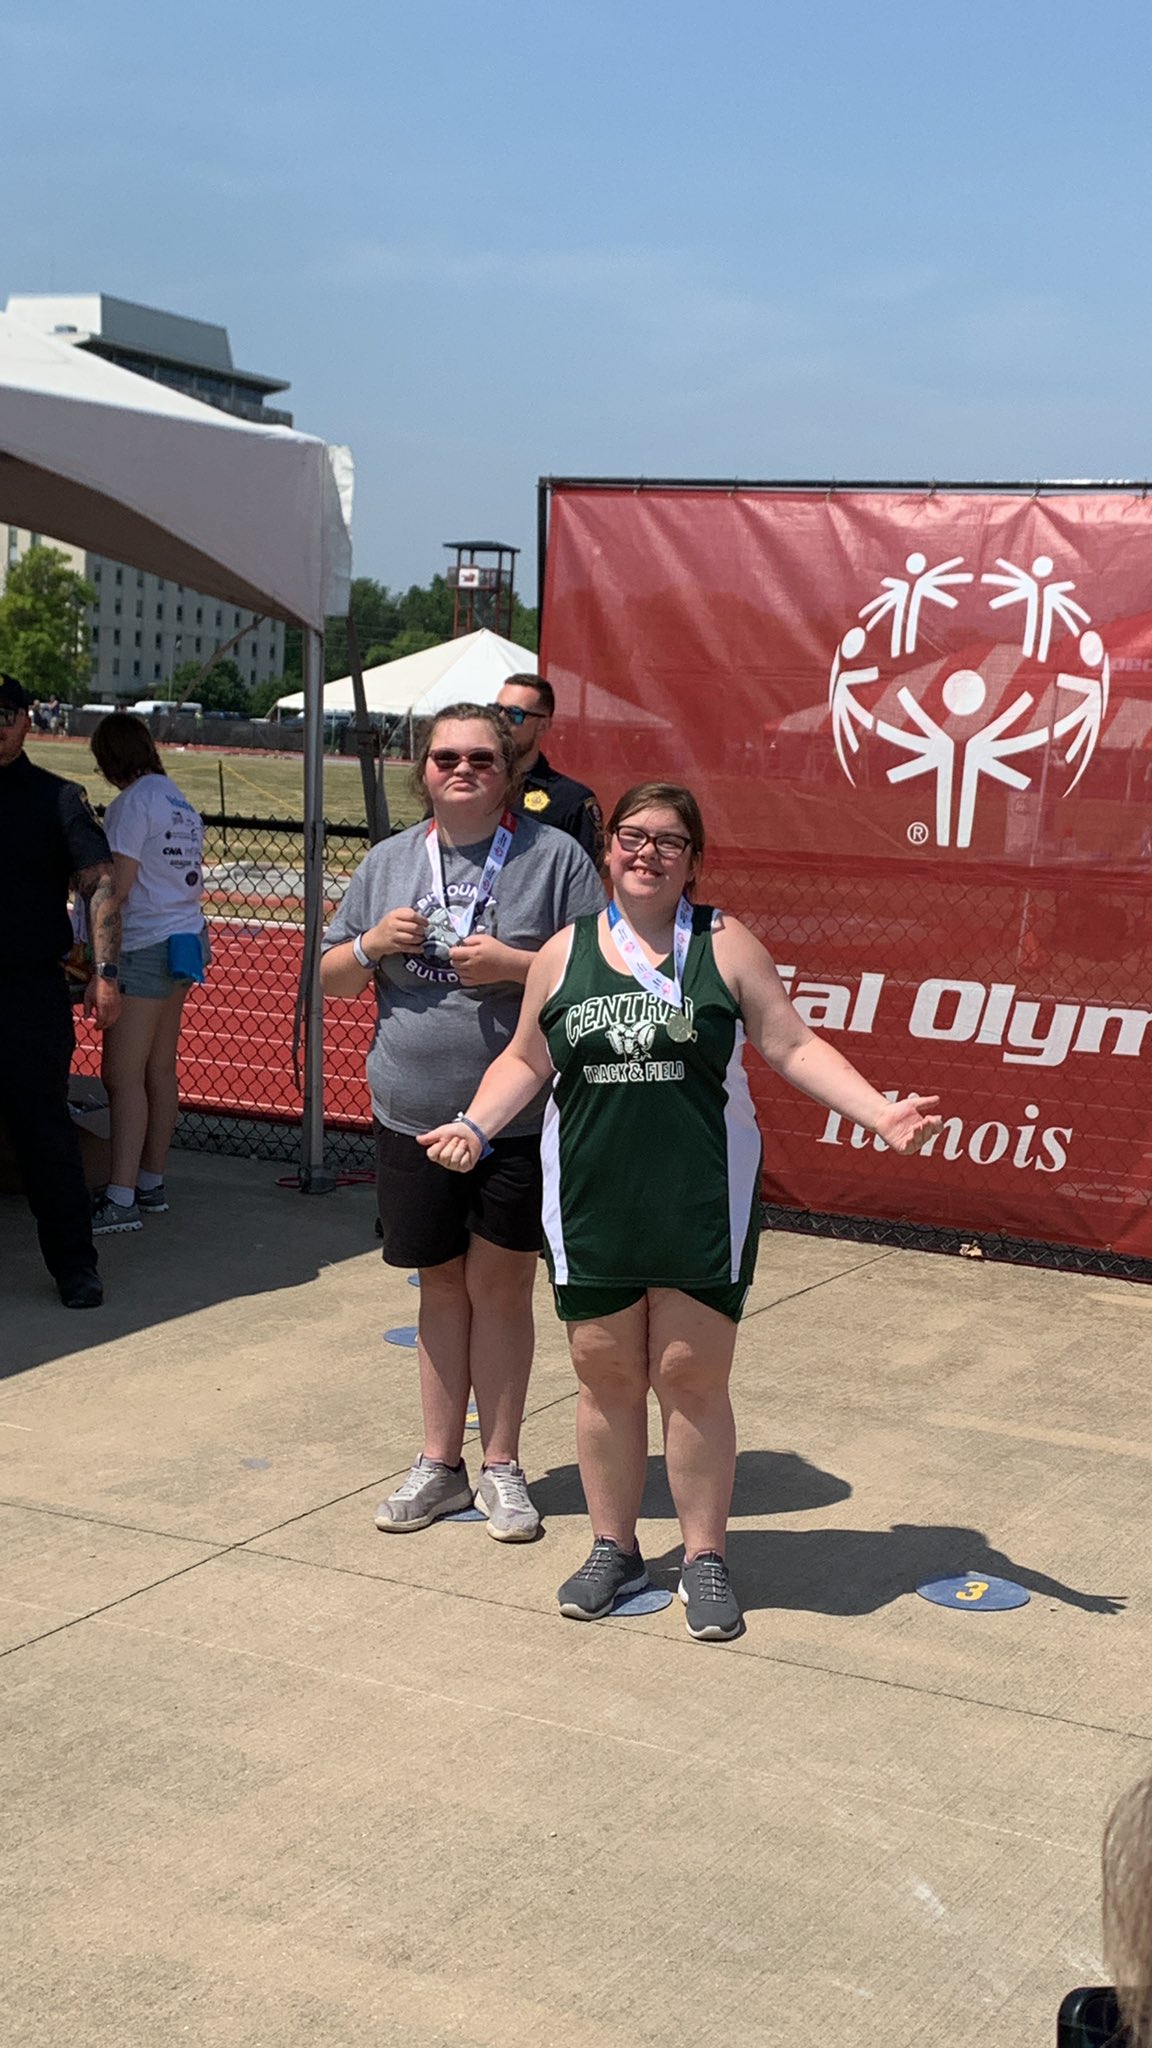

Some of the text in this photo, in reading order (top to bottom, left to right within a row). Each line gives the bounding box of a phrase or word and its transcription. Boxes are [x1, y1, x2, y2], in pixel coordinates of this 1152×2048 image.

[405, 959, 459, 983] BULLD
[908, 977, 1152, 1067] Olym
[583, 1060, 685, 1083] TRACK & FIELD
[816, 1089, 1073, 1173] Inois
[955, 1581, 989, 1602] 3
